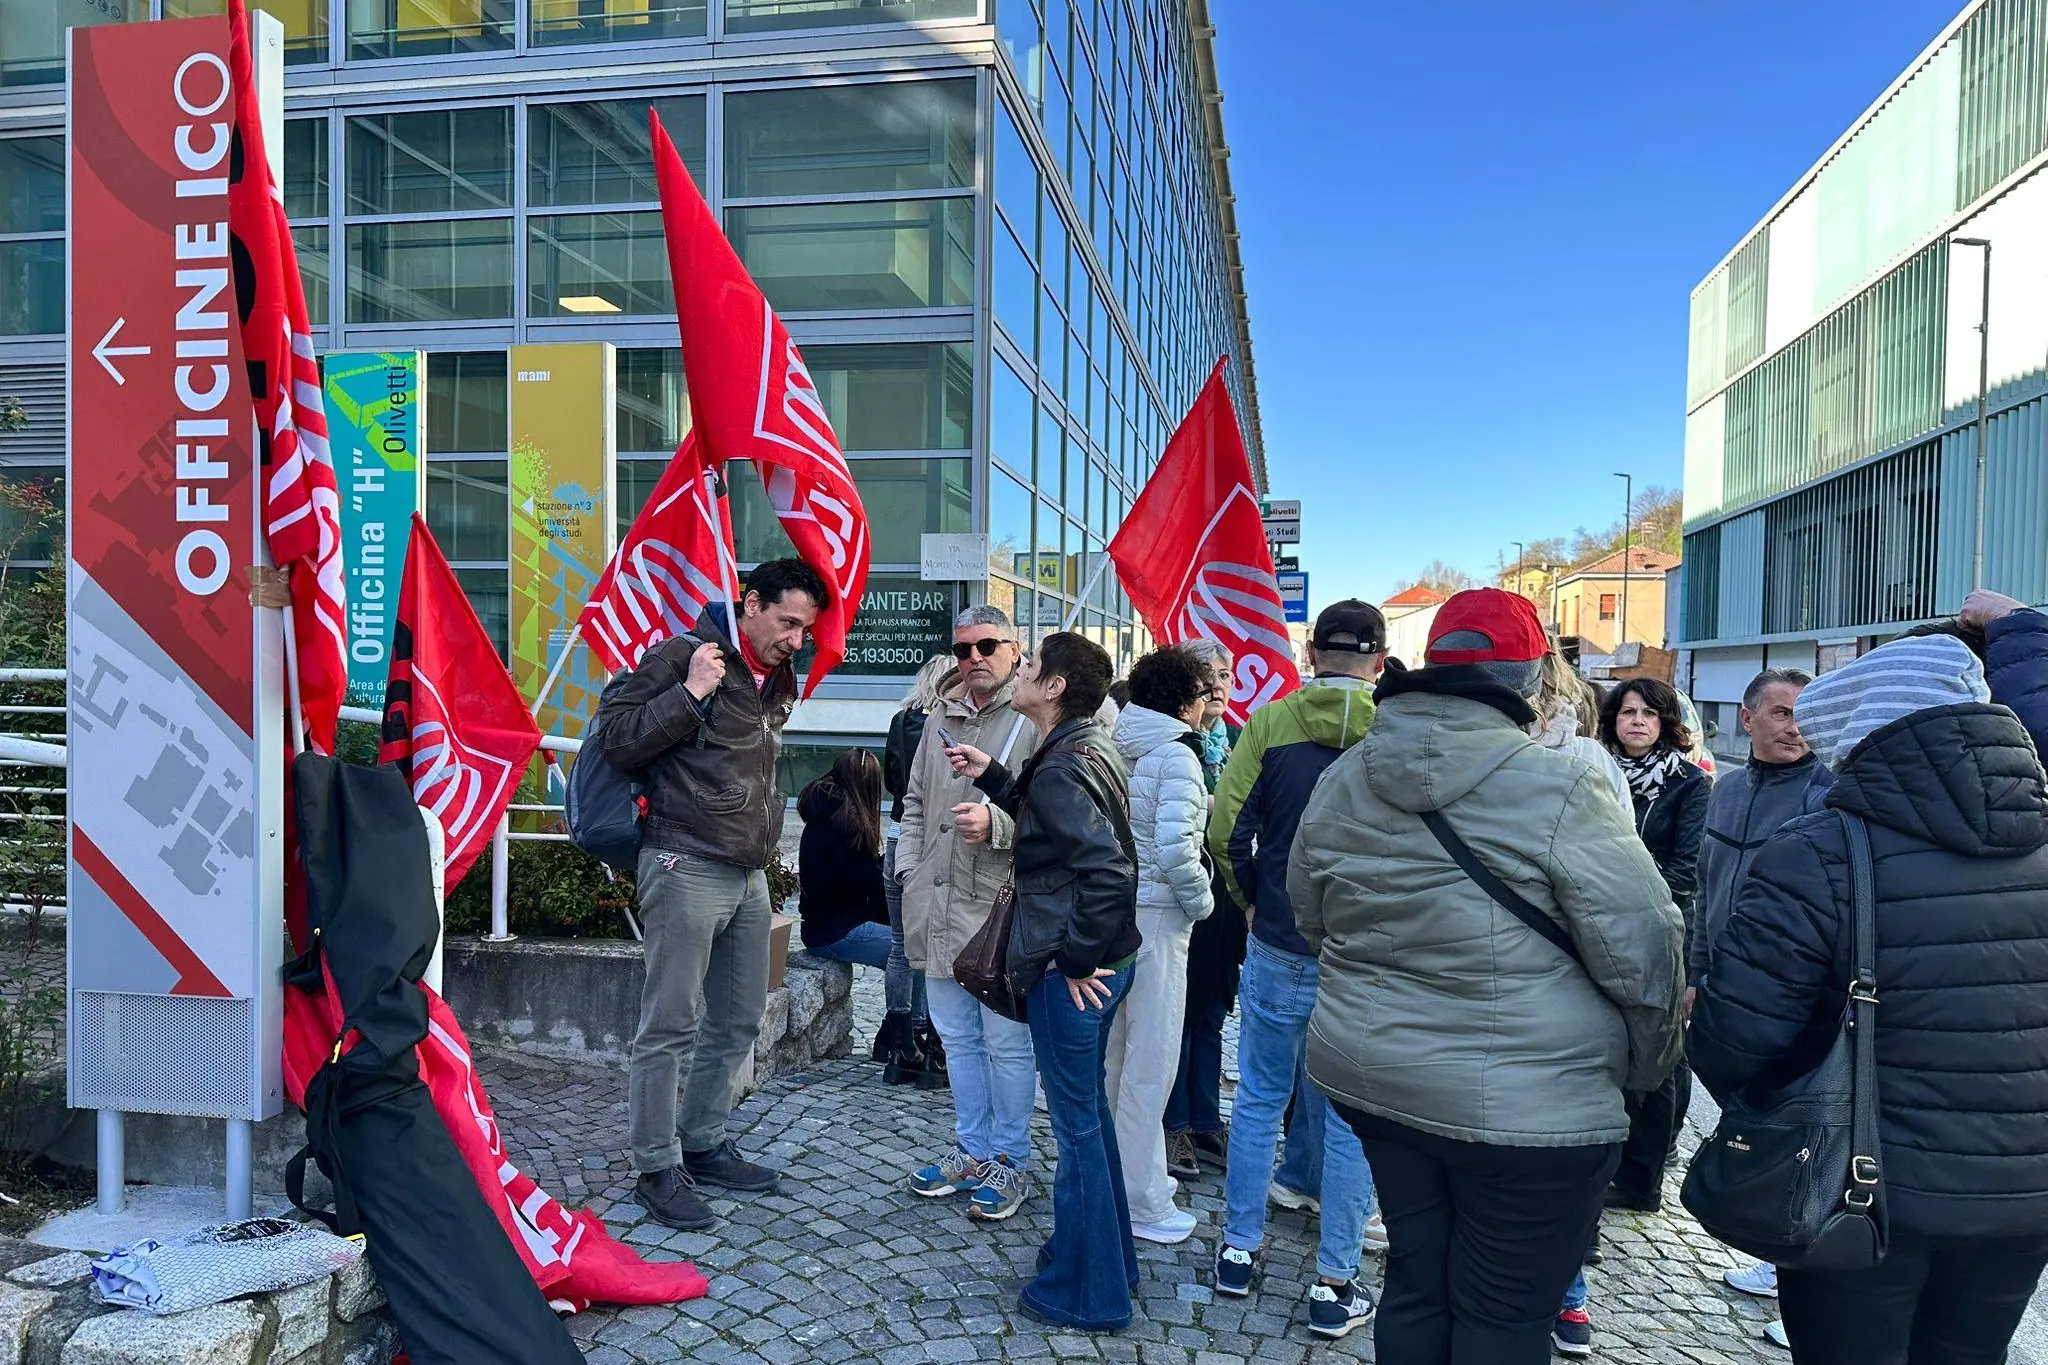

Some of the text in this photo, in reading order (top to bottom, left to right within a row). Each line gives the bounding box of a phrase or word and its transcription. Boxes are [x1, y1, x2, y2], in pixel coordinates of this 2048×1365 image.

[174, 52, 230, 595] OFFICINE ICO
[384, 366, 406, 453] Olivetti
[537, 502, 571, 510] stazione
[586, 502, 592, 510] 3
[538, 516, 580, 526] università
[538, 529, 582, 538] degli studi
[1276, 527, 1297, 536] Studi
[956, 559, 984, 568] NAVALE
[352, 521, 384, 664] Officina
[859, 591, 944, 611] RANTE BAR
[845, 633, 865, 641] ARIFFE
[866, 633, 894, 641] SPECIALI
[907, 633, 924, 641] TAKE
[349, 679, 388, 691] Area di
[350, 692, 386, 703] ultura
[1233, 1253, 1243, 1262] 19
[1314, 1290, 1326, 1300] 68
